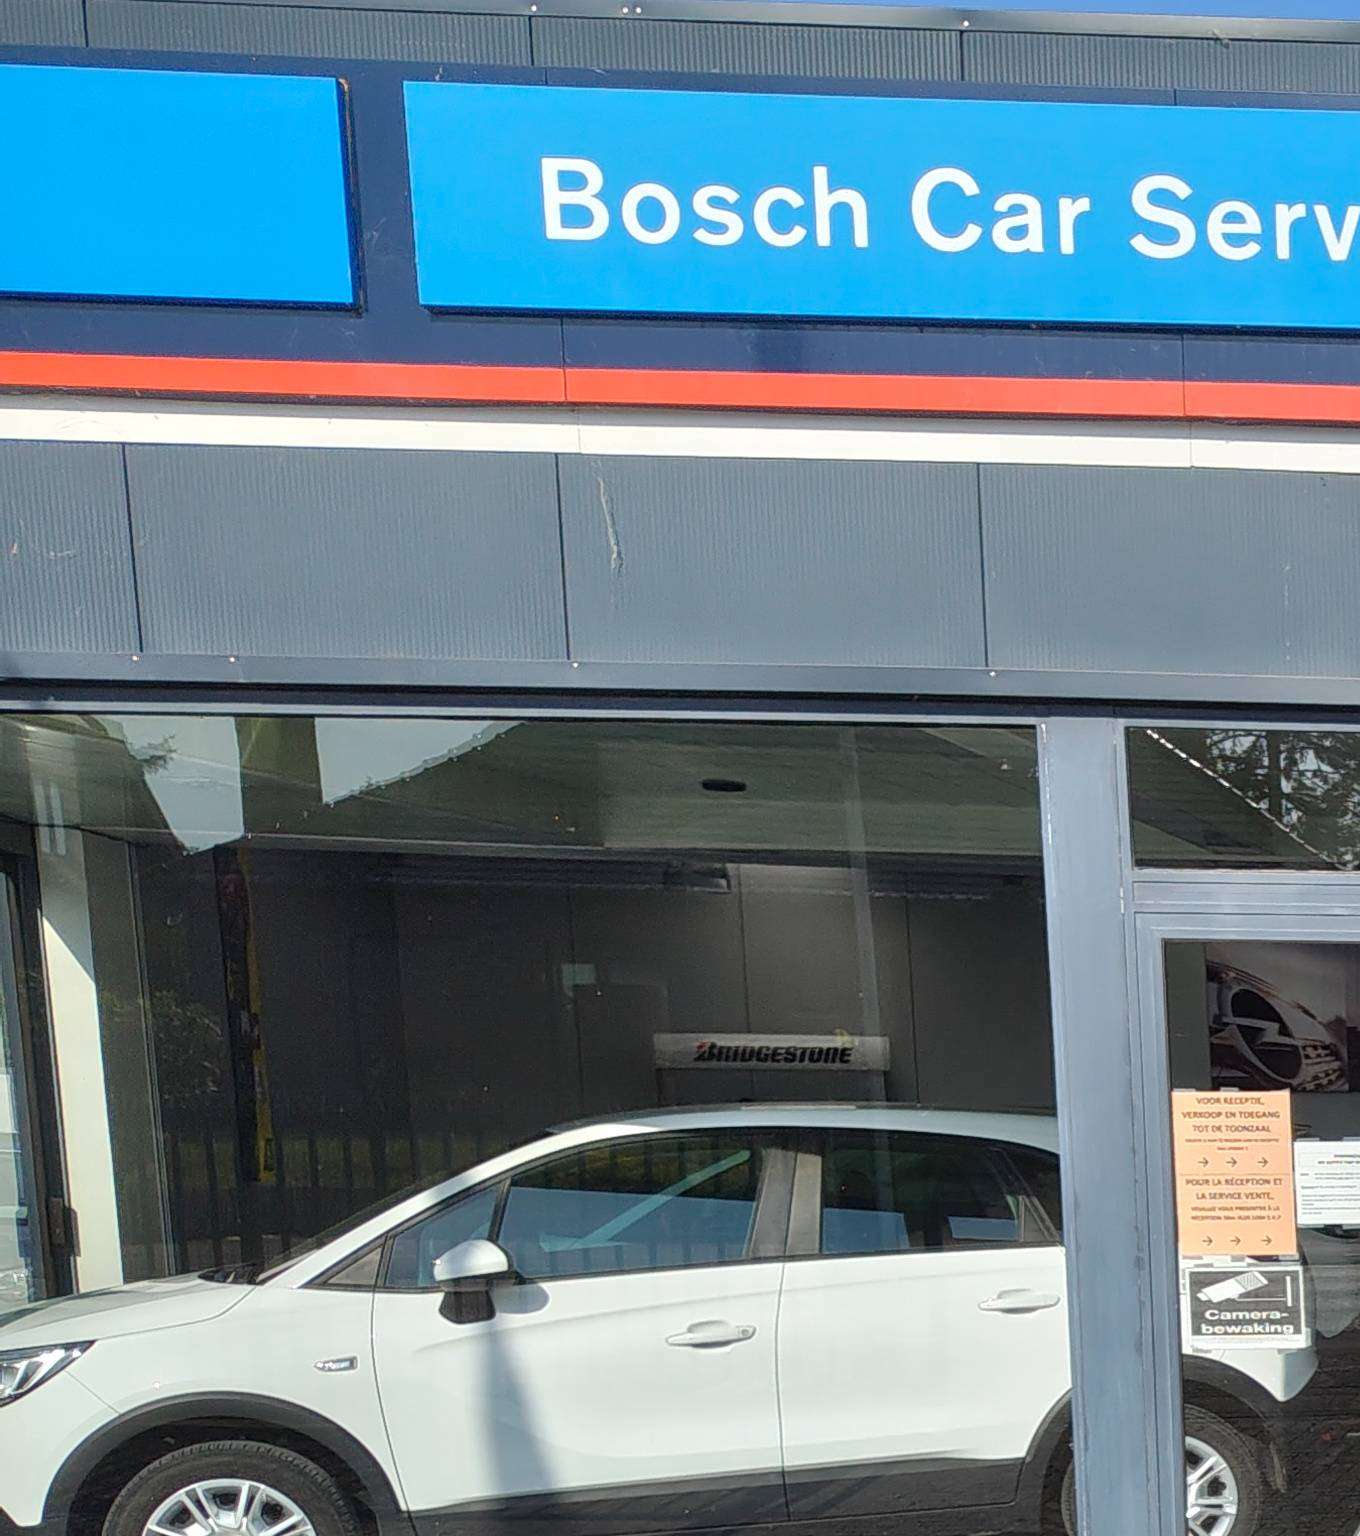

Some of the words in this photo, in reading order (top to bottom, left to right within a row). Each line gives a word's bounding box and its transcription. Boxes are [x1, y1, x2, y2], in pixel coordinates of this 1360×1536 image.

[540, 157, 869, 248] Bosch
[911, 167, 1091, 255] Car
[693, 1040, 854, 1064] BRIDGESTONE
[1195, 1096, 1221, 1106] VOOR
[1181, 1110, 1223, 1120] VERKOOP
[1225, 1110, 1237, 1119] EN
[1239, 1110, 1281, 1119] TOEGANG
[1192, 1124, 1209, 1133] TOT
[1211, 1124, 1223, 1133] DE
[1225, 1124, 1271, 1133] TOONZAAL
[1184, 1178, 1210, 1186] POUR
[1211, 1178, 1222, 1186] LA
[1195, 1191, 1206, 1200] LA
[1208, 1191, 1243, 1200] SERVICE
[1203, 1308, 1290, 1321] Camera-
[1200, 1322, 1295, 1335] bewaking
